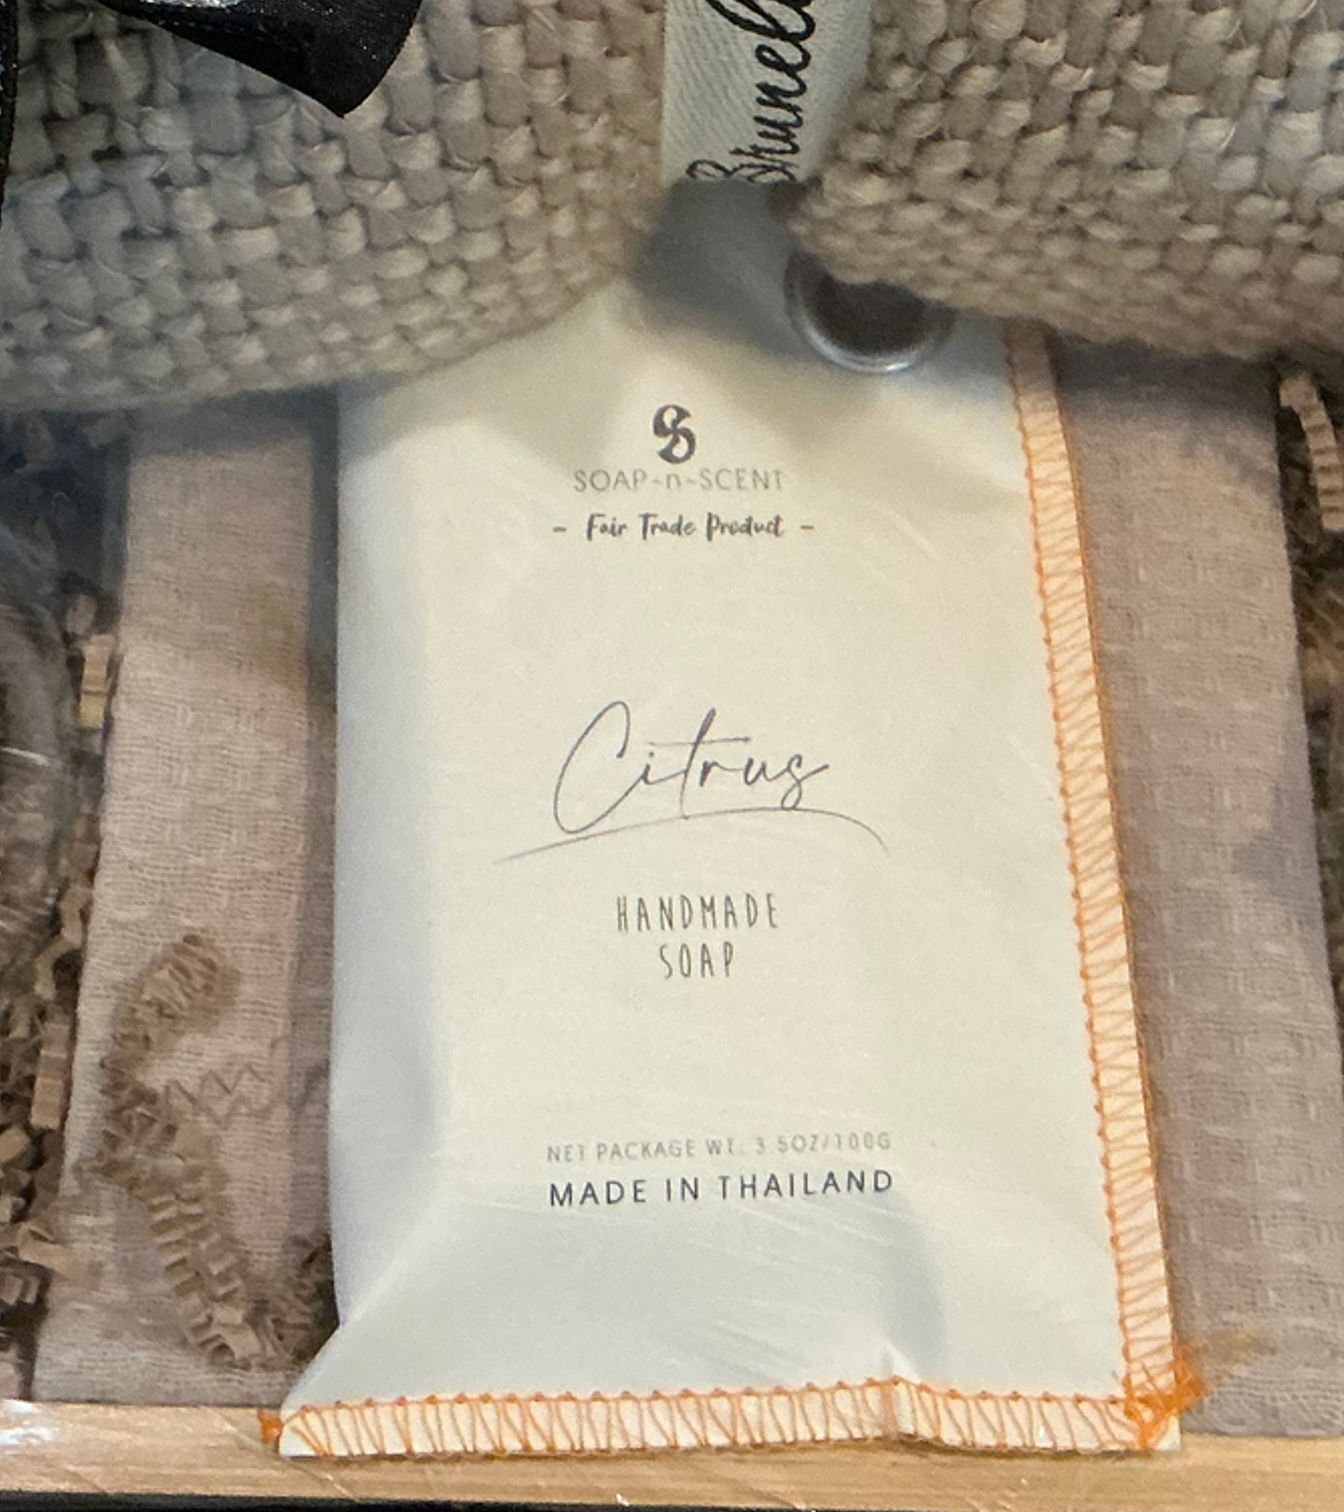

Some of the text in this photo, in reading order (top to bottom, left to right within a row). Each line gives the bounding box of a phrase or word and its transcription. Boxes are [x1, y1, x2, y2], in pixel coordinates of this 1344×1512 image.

[572, 467, 783, 493] SOAP-n-SCENT
[586, 511, 784, 542] Fair Trade Product
[553, 700, 831, 835] Citrus
[615, 892, 780, 935] HANDMADE
[659, 942, 734, 980] SOAP
[546, 1144, 587, 1164] NET
[596, 1137, 696, 1161] PACKAGE
[549, 1169, 895, 1208] MADE IN THAILAND
